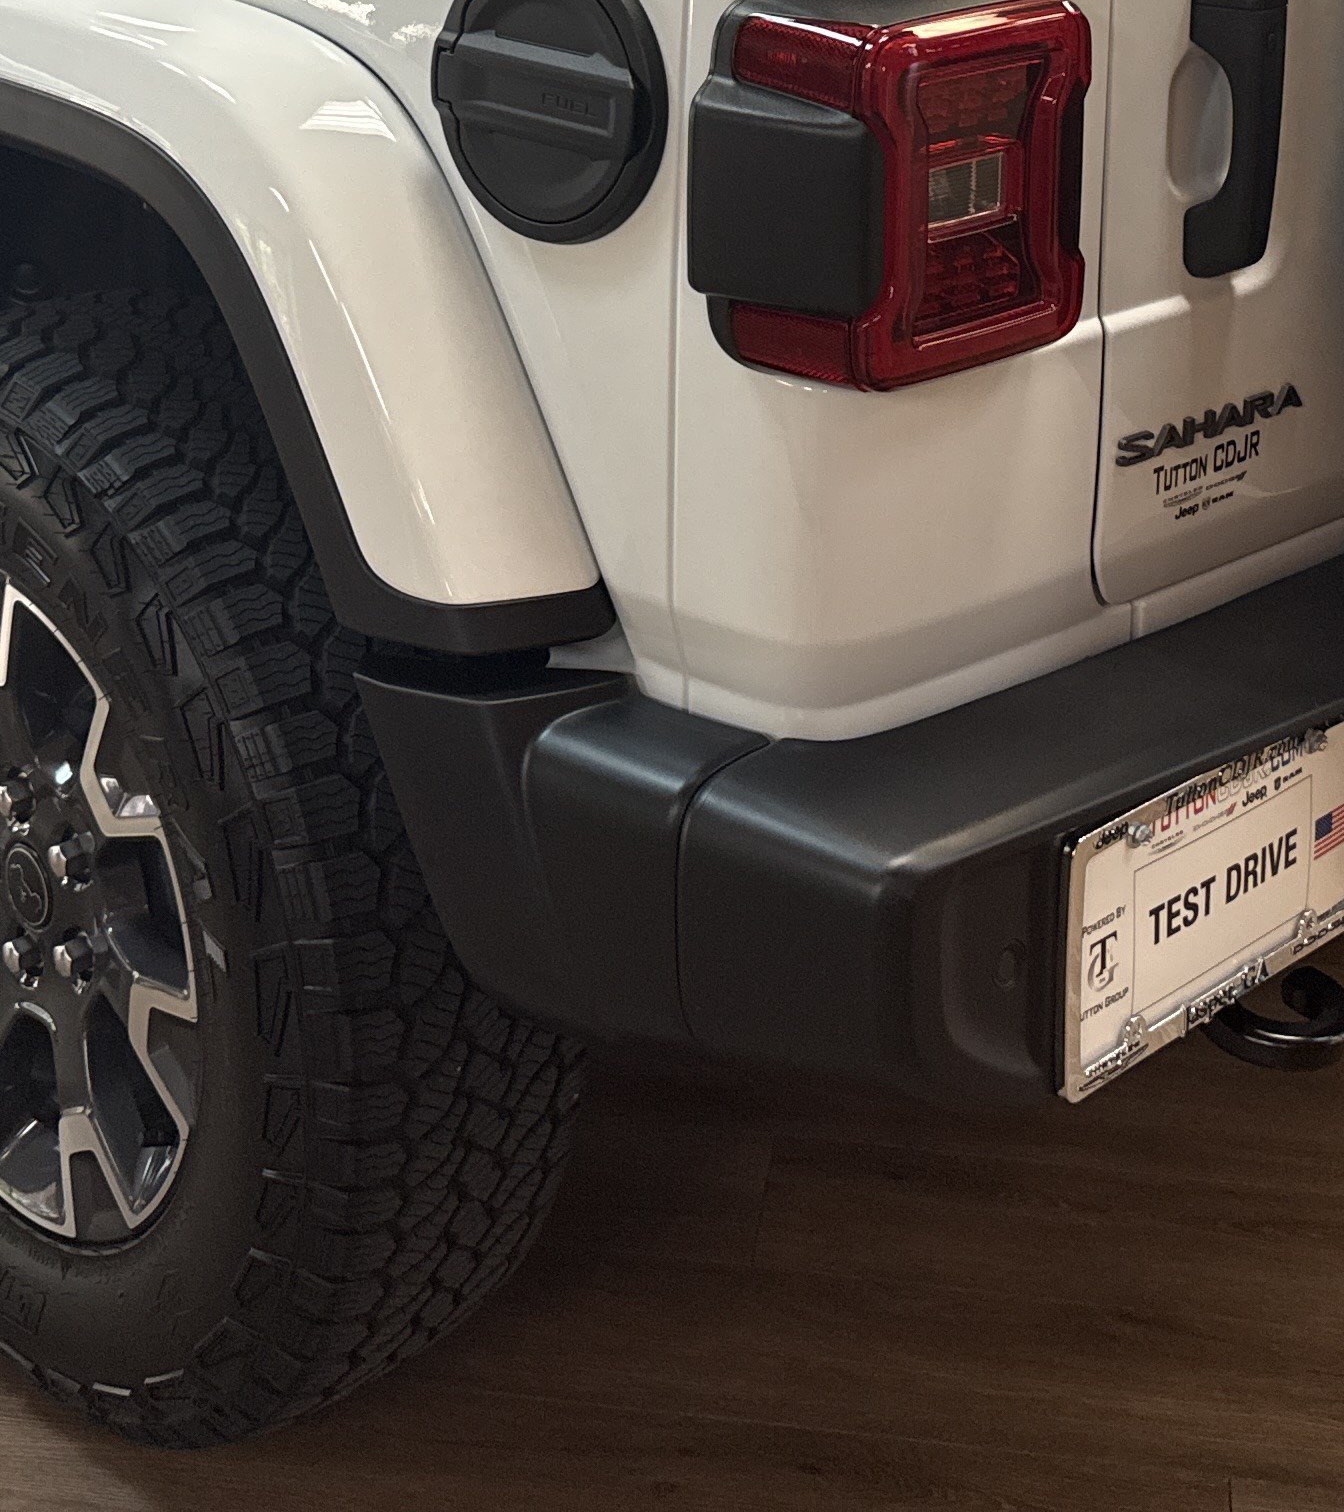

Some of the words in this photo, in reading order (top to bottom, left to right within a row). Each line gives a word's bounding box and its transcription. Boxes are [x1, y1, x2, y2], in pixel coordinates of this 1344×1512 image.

[1115, 382, 1303, 467] SAHARA
[1213, 429, 1260, 473] CDJR
[1175, 503, 1200, 520] Jeep
[1241, 784, 1268, 807] Jeep
[1148, 874, 1217, 946] TEST
[1225, 827, 1299, 906] DRIVE
[1079, 1000, 1104, 1023] UTTON
